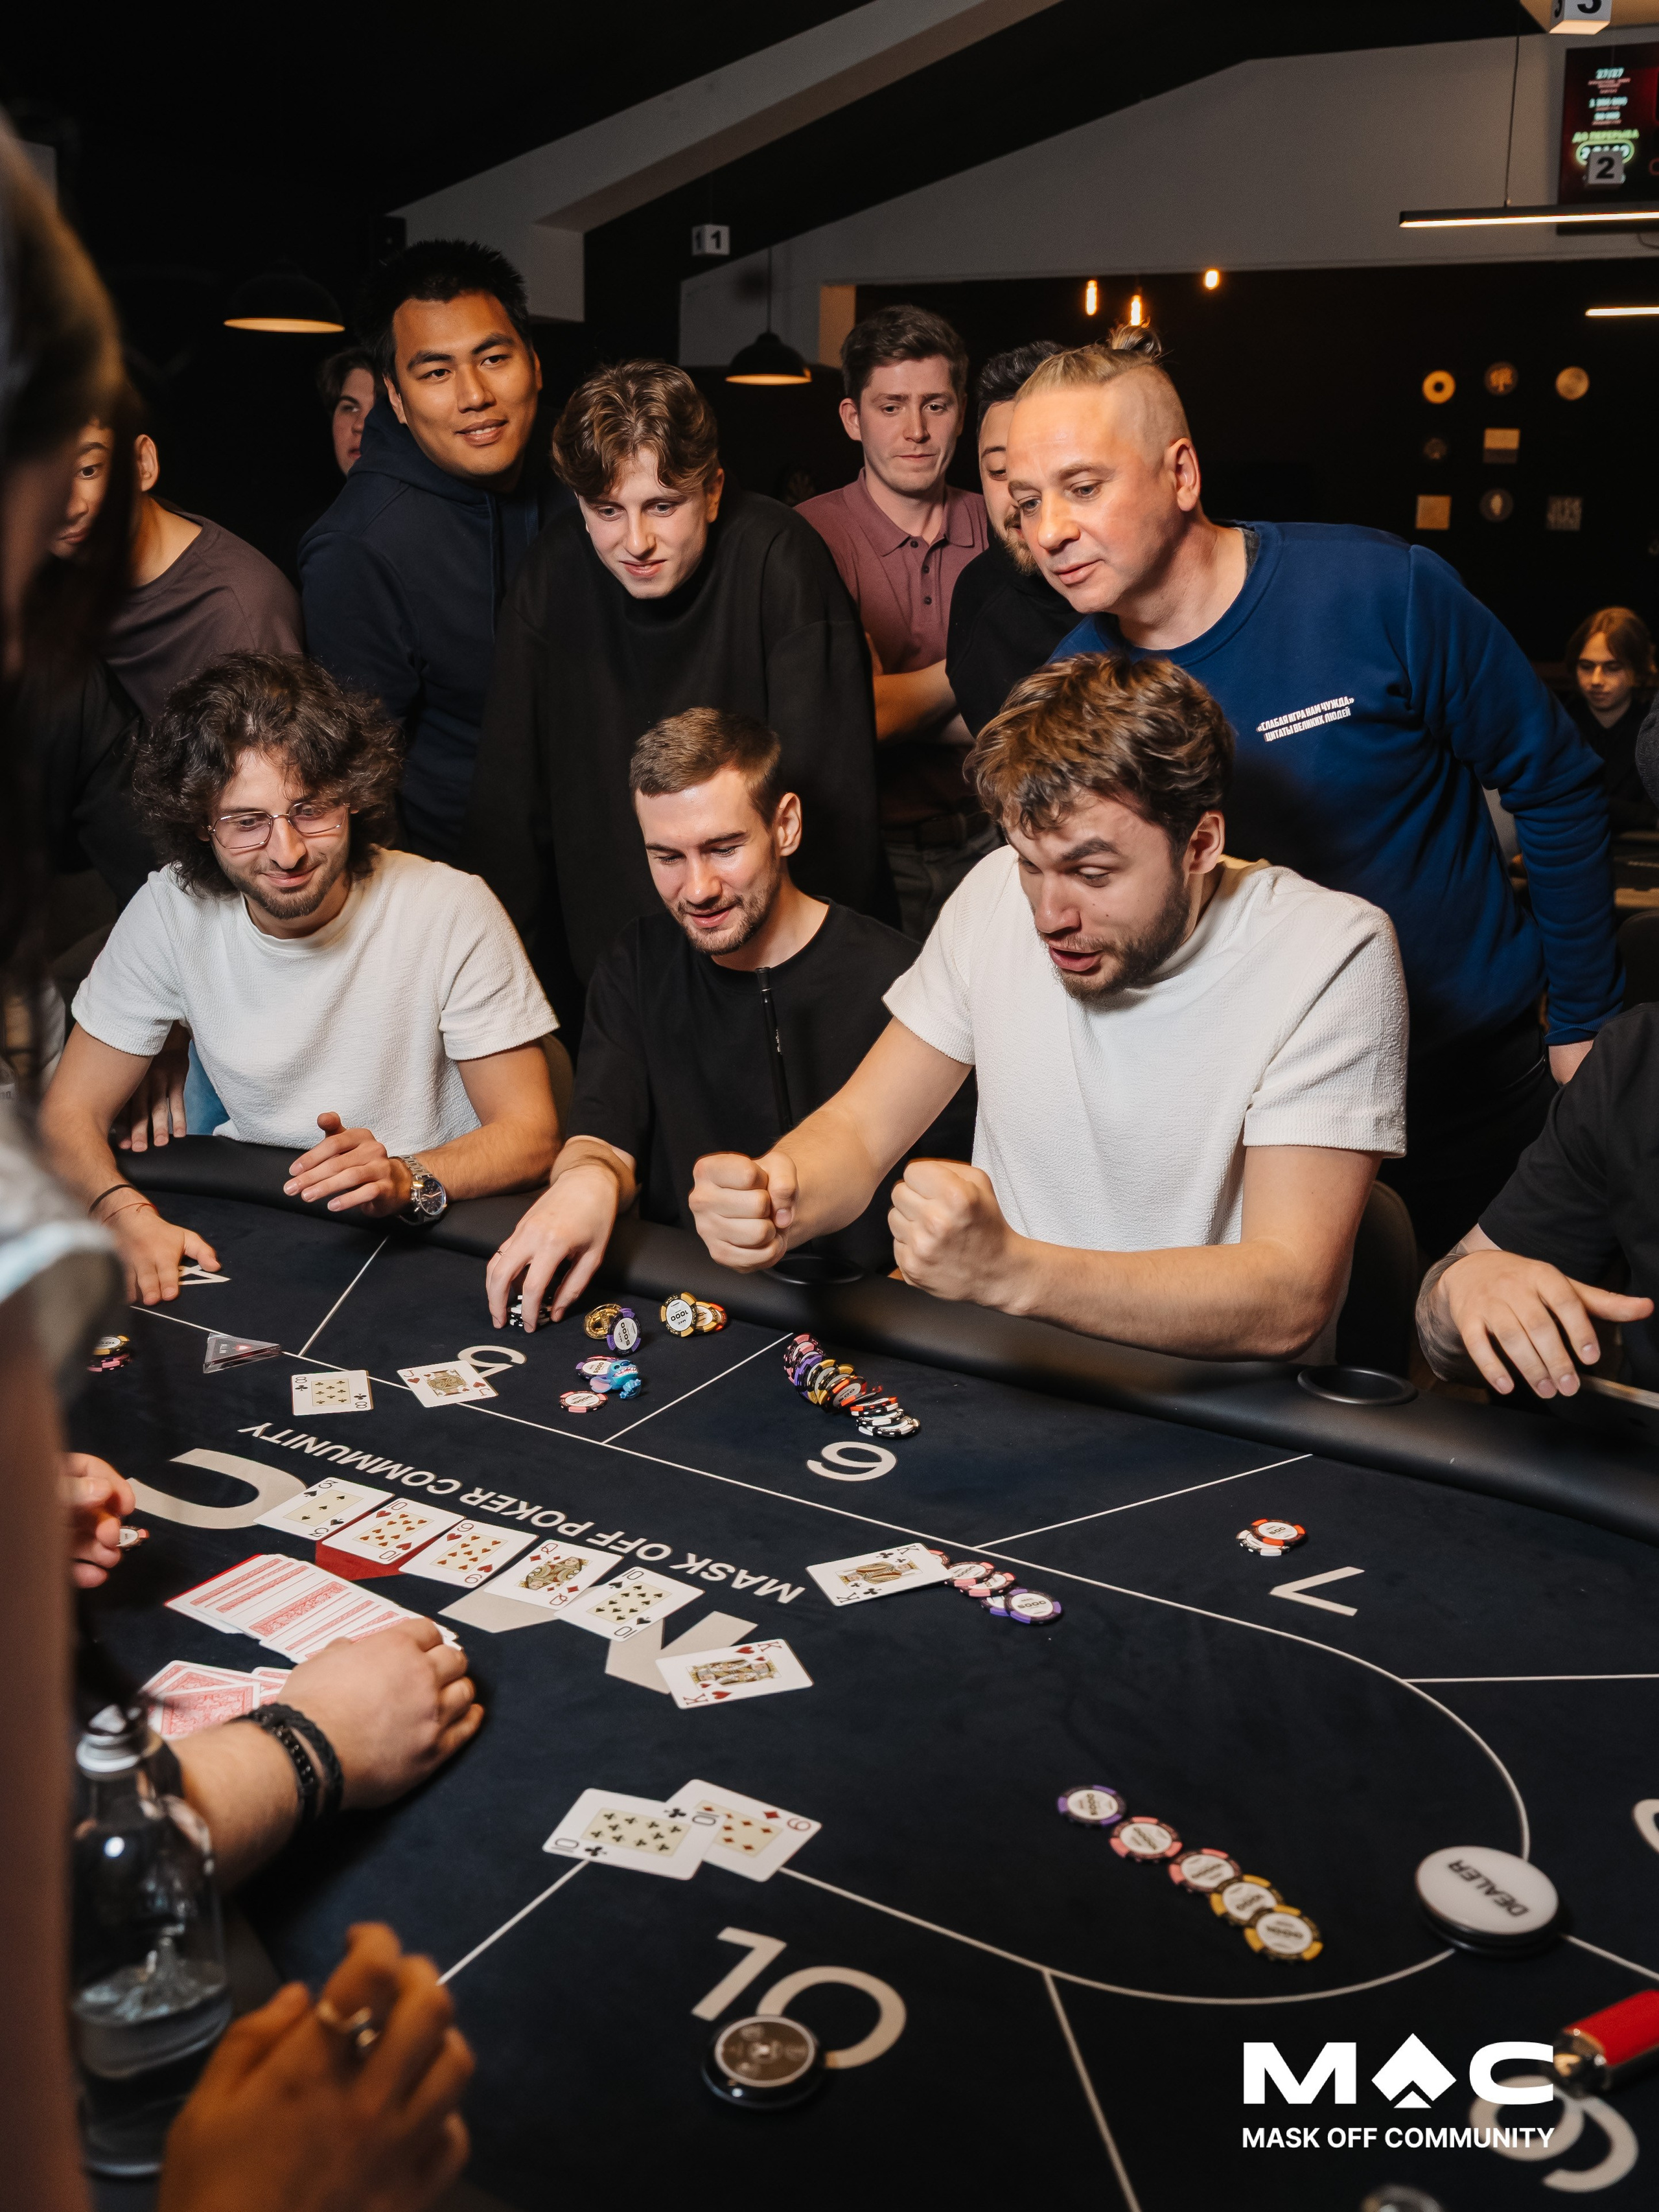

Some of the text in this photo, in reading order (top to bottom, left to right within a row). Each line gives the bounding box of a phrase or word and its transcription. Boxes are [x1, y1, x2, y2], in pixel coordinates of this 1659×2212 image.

[1596, 156, 1614, 179] 2
[711, 230, 721, 250] 1
[671, 1310, 688, 1321] 1000
[621, 1322, 631, 1346] 5000
[806, 1441, 898, 1481] 6
[319, 1480, 338, 1489] 3
[387, 1501, 408, 1510] 10
[237, 1422, 806, 1604] MASK OFF POKER COMMUNITY
[308, 1527, 329, 1538] 3
[458, 1523, 474, 1532] 9
[540, 1543, 558, 1554] Q
[897, 1545, 919, 1554] K
[378, 1550, 402, 1561] 10
[623, 1569, 644, 1580] 10
[1269, 1566, 1364, 1616] 7
[550, 1593, 568, 1606] Q
[837, 1592, 860, 1603] K
[614, 1626, 638, 1639] 10
[758, 1641, 782, 1652] K
[683, 1693, 708, 1705] K
[692, 1812, 719, 1826] 10
[551, 1838, 579, 1852] 10
[1448, 1860, 1529, 1917] DEALER
[692, 1927, 907, 2069] 10
